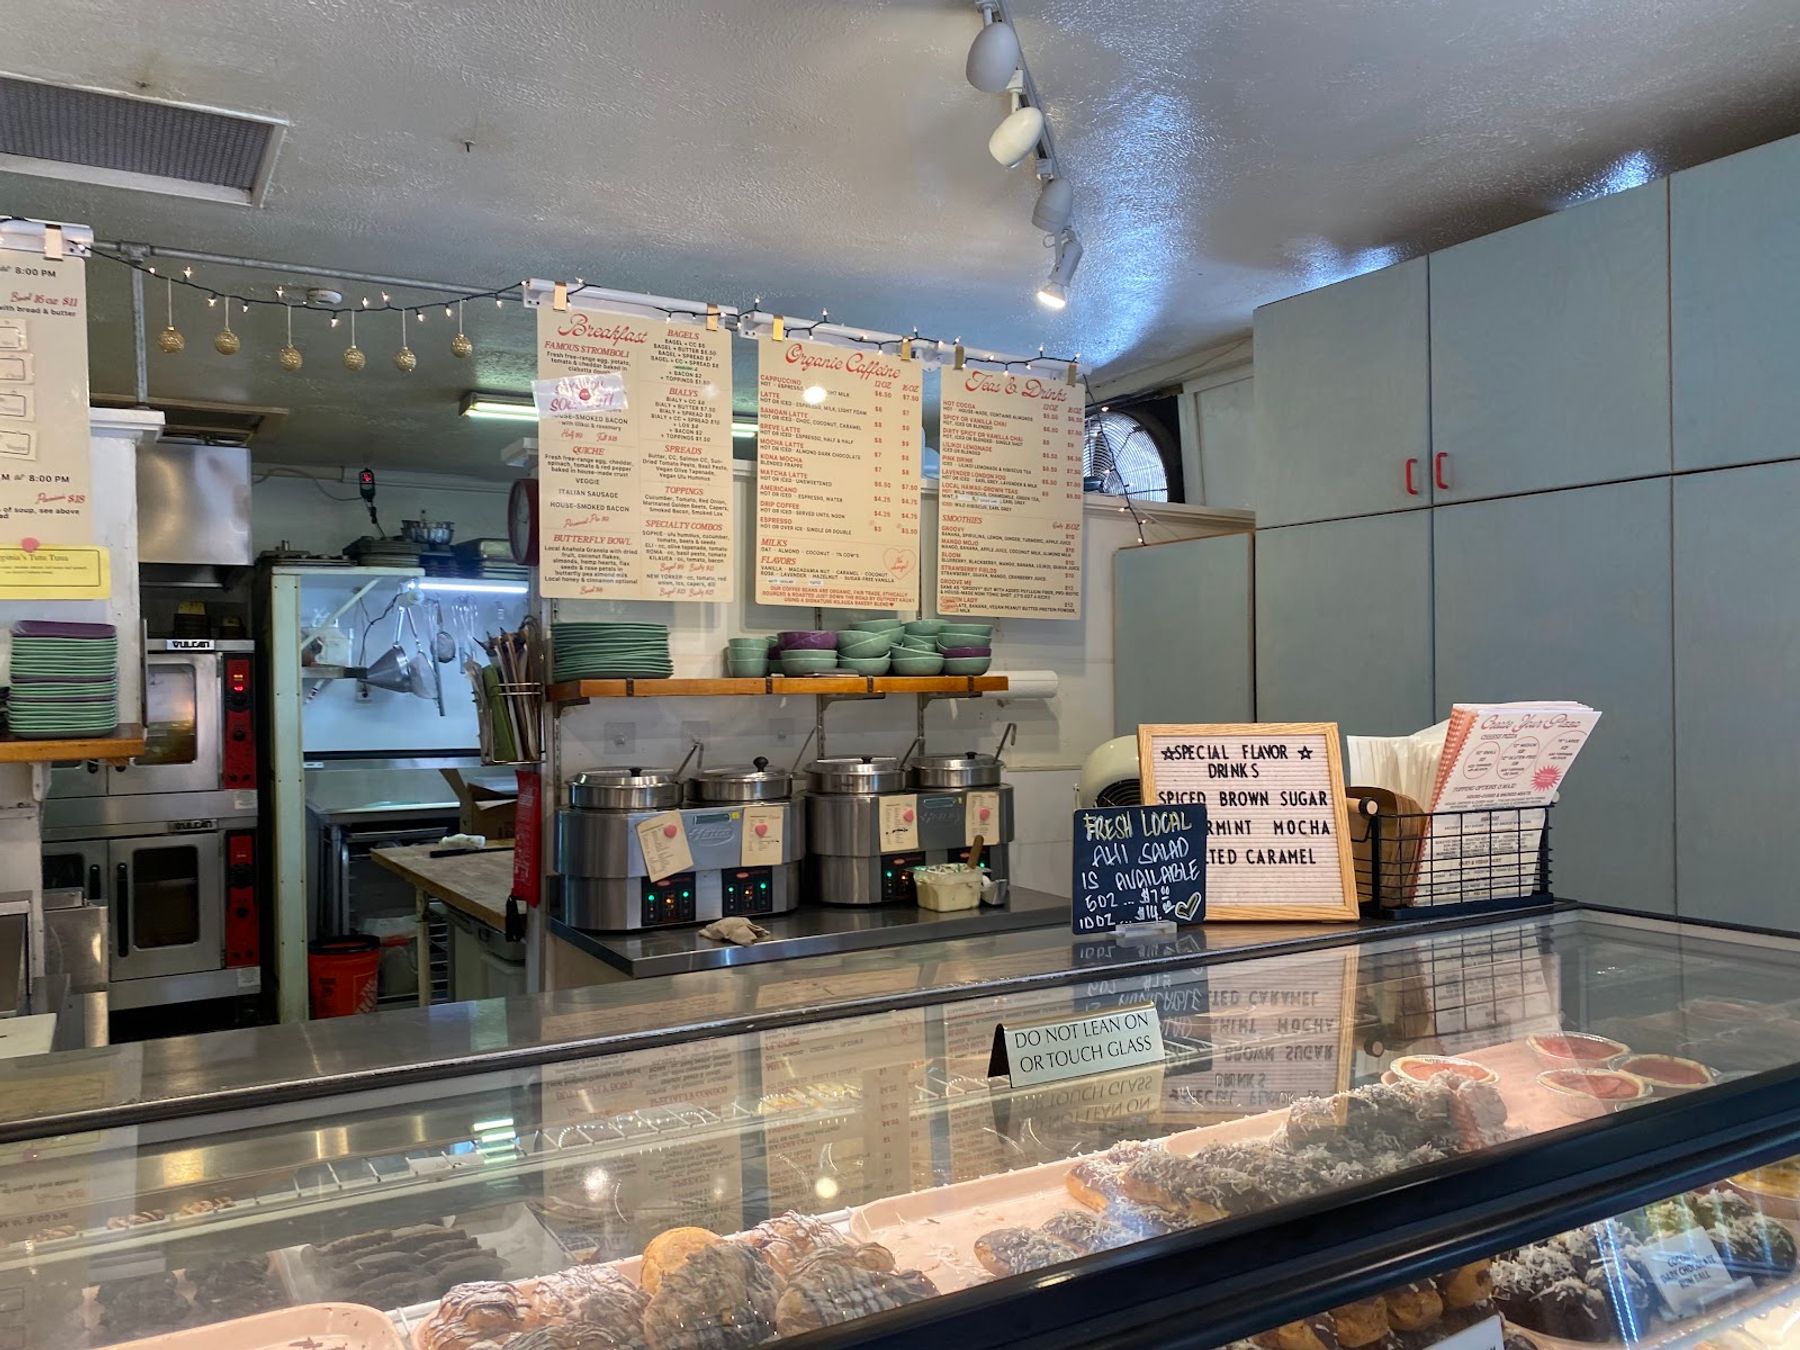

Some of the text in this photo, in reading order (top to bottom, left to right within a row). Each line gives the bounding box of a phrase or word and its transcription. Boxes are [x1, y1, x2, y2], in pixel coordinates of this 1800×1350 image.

[15, 267, 38, 276] 8:00
[558, 313, 648, 345] Breakfast
[667, 329, 699, 340] BAGELS
[545, 340, 629, 358] FAMOUS STROMBOLI
[658, 350, 676, 358] BAGEL
[565, 353, 595, 362] free-range
[786, 344, 900, 379] Organic Caffeine
[760, 375, 801, 385] CAPPUCCINO
[965, 371, 1000, 393] Teas
[1021, 379, 1067, 402] Drinks
[669, 388, 698, 397] BIALYS
[760, 391, 780, 399] LATTE
[760, 407, 808, 418] SAMOAN LATTE
[760, 438, 783, 446] MOCHA
[573, 446, 605, 455] QUICHE
[664, 445, 702, 455] SPREADS
[963, 444, 992, 452] LEMONADE
[780, 455, 802, 463] MOCHA
[760, 469, 808, 479] MATCHA LATTE
[665, 486, 703, 495] TOPPINGS
[550, 502, 629, 512] HOUSE-SMOKED BACON
[943, 515, 982, 524] SMOOTHIES
[646, 520, 722, 531] SPECIALTY COMBOS
[554, 535, 632, 545] BUTTERFLY BOWL
[761, 538, 787, 546] MILKS
[761, 556, 796, 565] FLAVORS
[1175, 744, 1288, 760] SPECIAL FLAVOR
[1208, 763, 1259, 778] DRINKS
[1220, 791, 1269, 806] BROWN
[1281, 791, 1328, 806] SUGAR
[1084, 810, 1192, 841] FRESH LOCAL
[1207, 820, 1330, 835] RMINT MOCHA
[1092, 836, 1189, 867] AHI SALAD
[1206, 848, 1316, 865] TED CARAMEL
[1082, 859, 1200, 891] IS AVAILABLE
[1015, 1013, 1149, 1049] DO NOT LEAN ON
[1020, 1035, 1152, 1072] OR TOUCH GLASS
